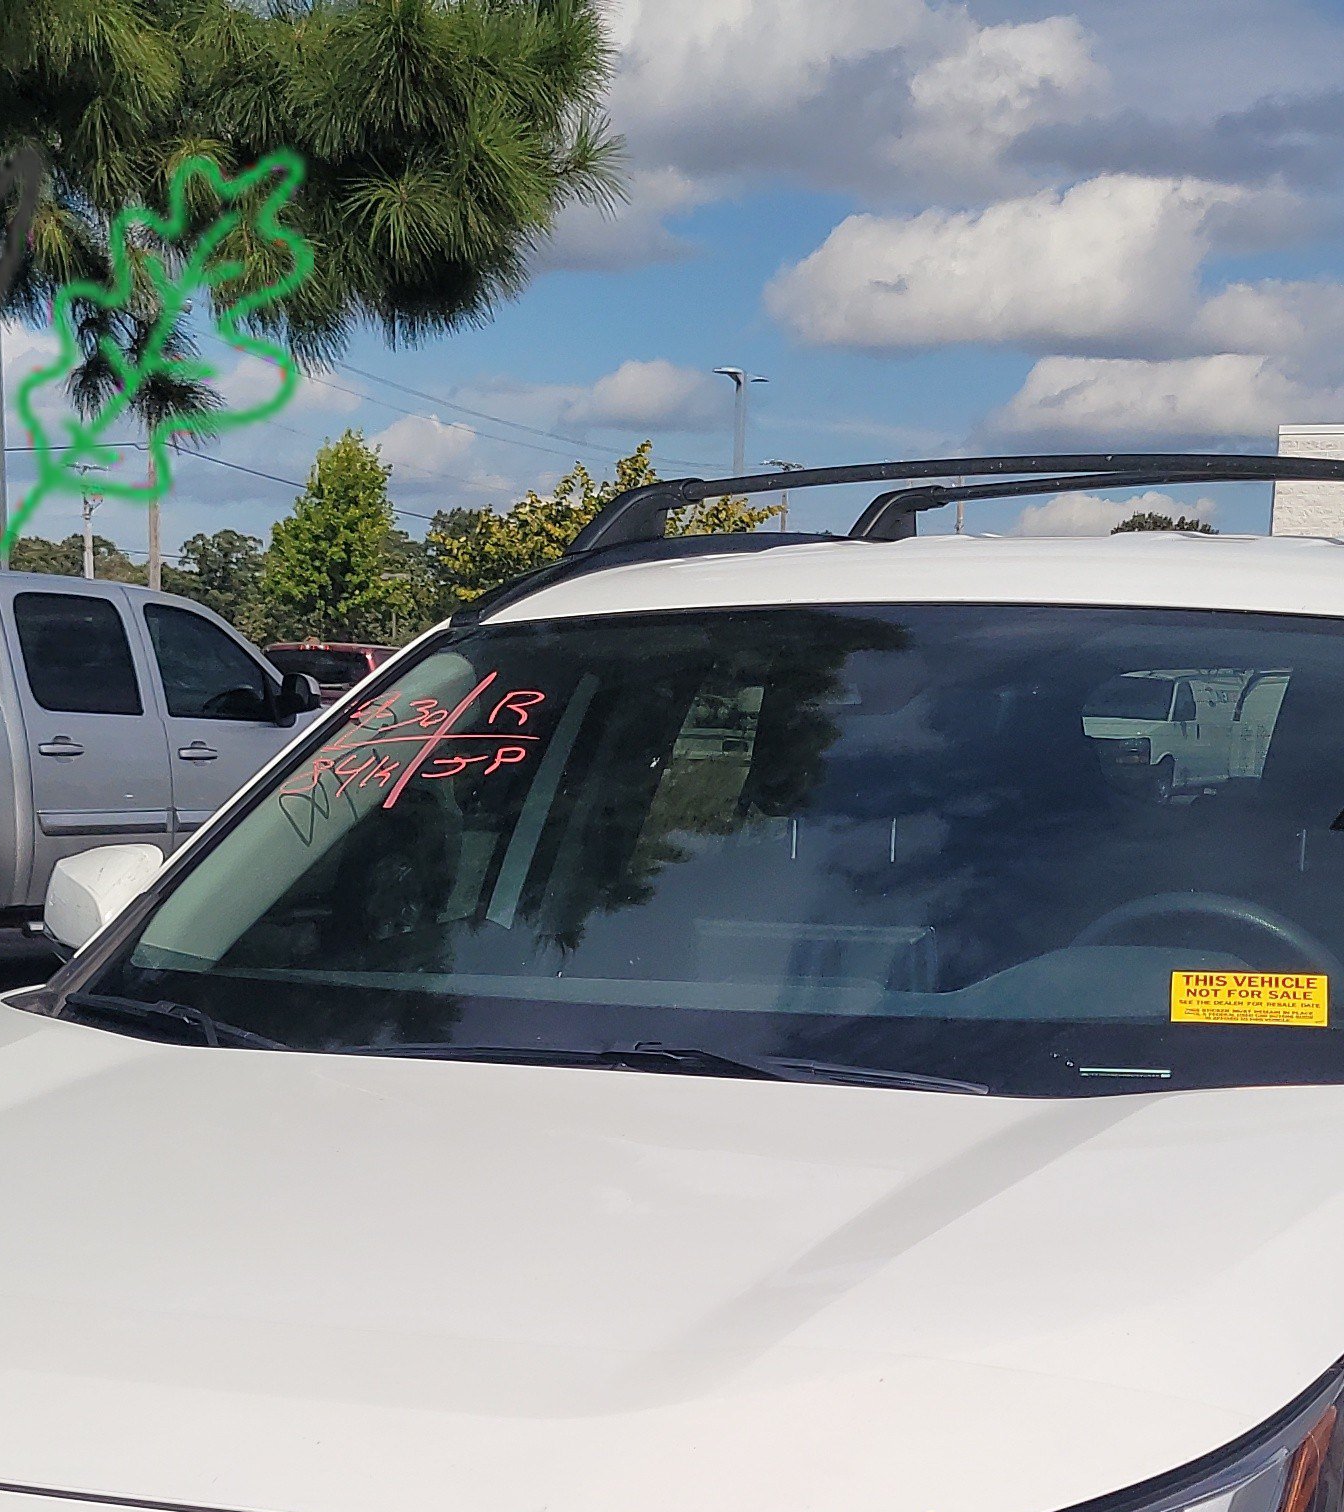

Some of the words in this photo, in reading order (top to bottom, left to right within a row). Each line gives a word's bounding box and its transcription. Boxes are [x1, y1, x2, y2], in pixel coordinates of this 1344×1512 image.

[1182, 975, 1228, 987] THIS
[1233, 976, 1318, 989] VEHICLE
[1186, 988, 1221, 998] NOT
[1227, 989, 1262, 999] FOR
[1268, 990, 1313, 1001] SALE
